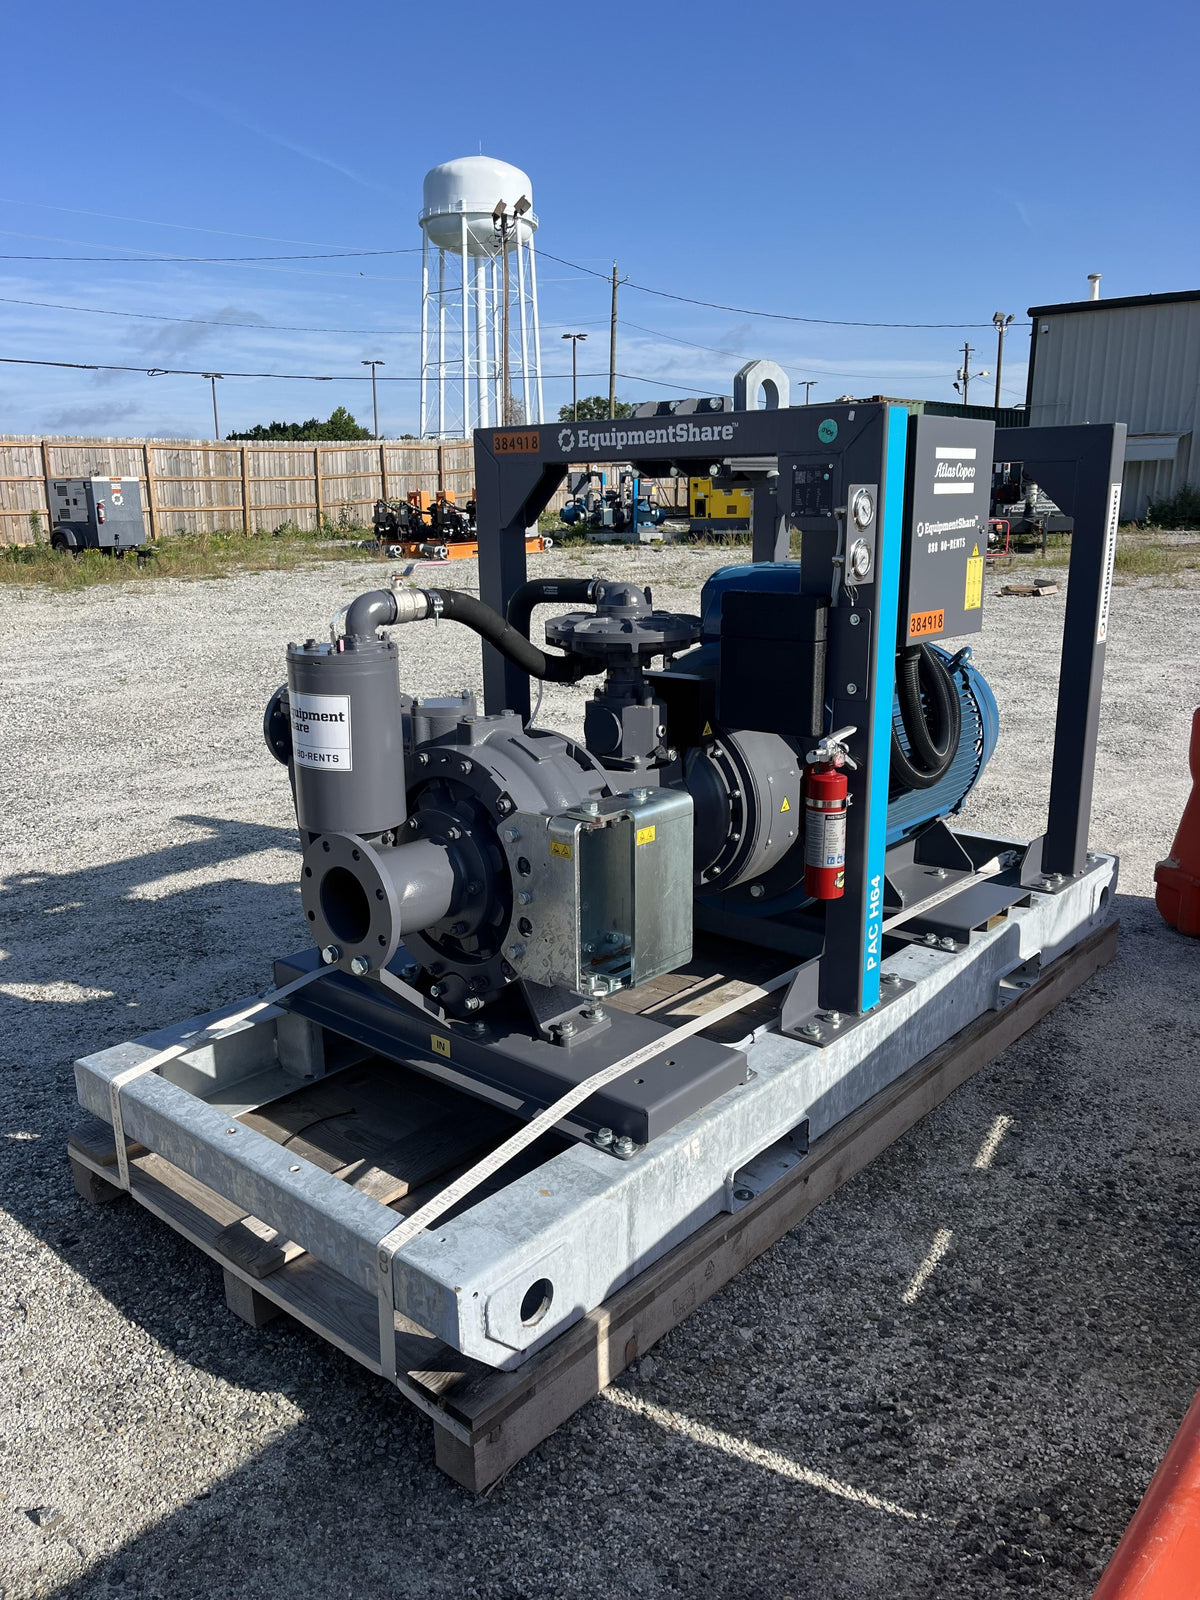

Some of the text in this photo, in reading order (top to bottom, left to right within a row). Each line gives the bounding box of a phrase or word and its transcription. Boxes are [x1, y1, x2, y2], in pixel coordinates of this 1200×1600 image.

[495, 436, 538, 450] 384918
[927, 541, 938, 553] 888
[910, 613, 943, 633] 384918
[866, 874, 881, 971] PAC H64
[436, 1040, 445, 1051] IN
